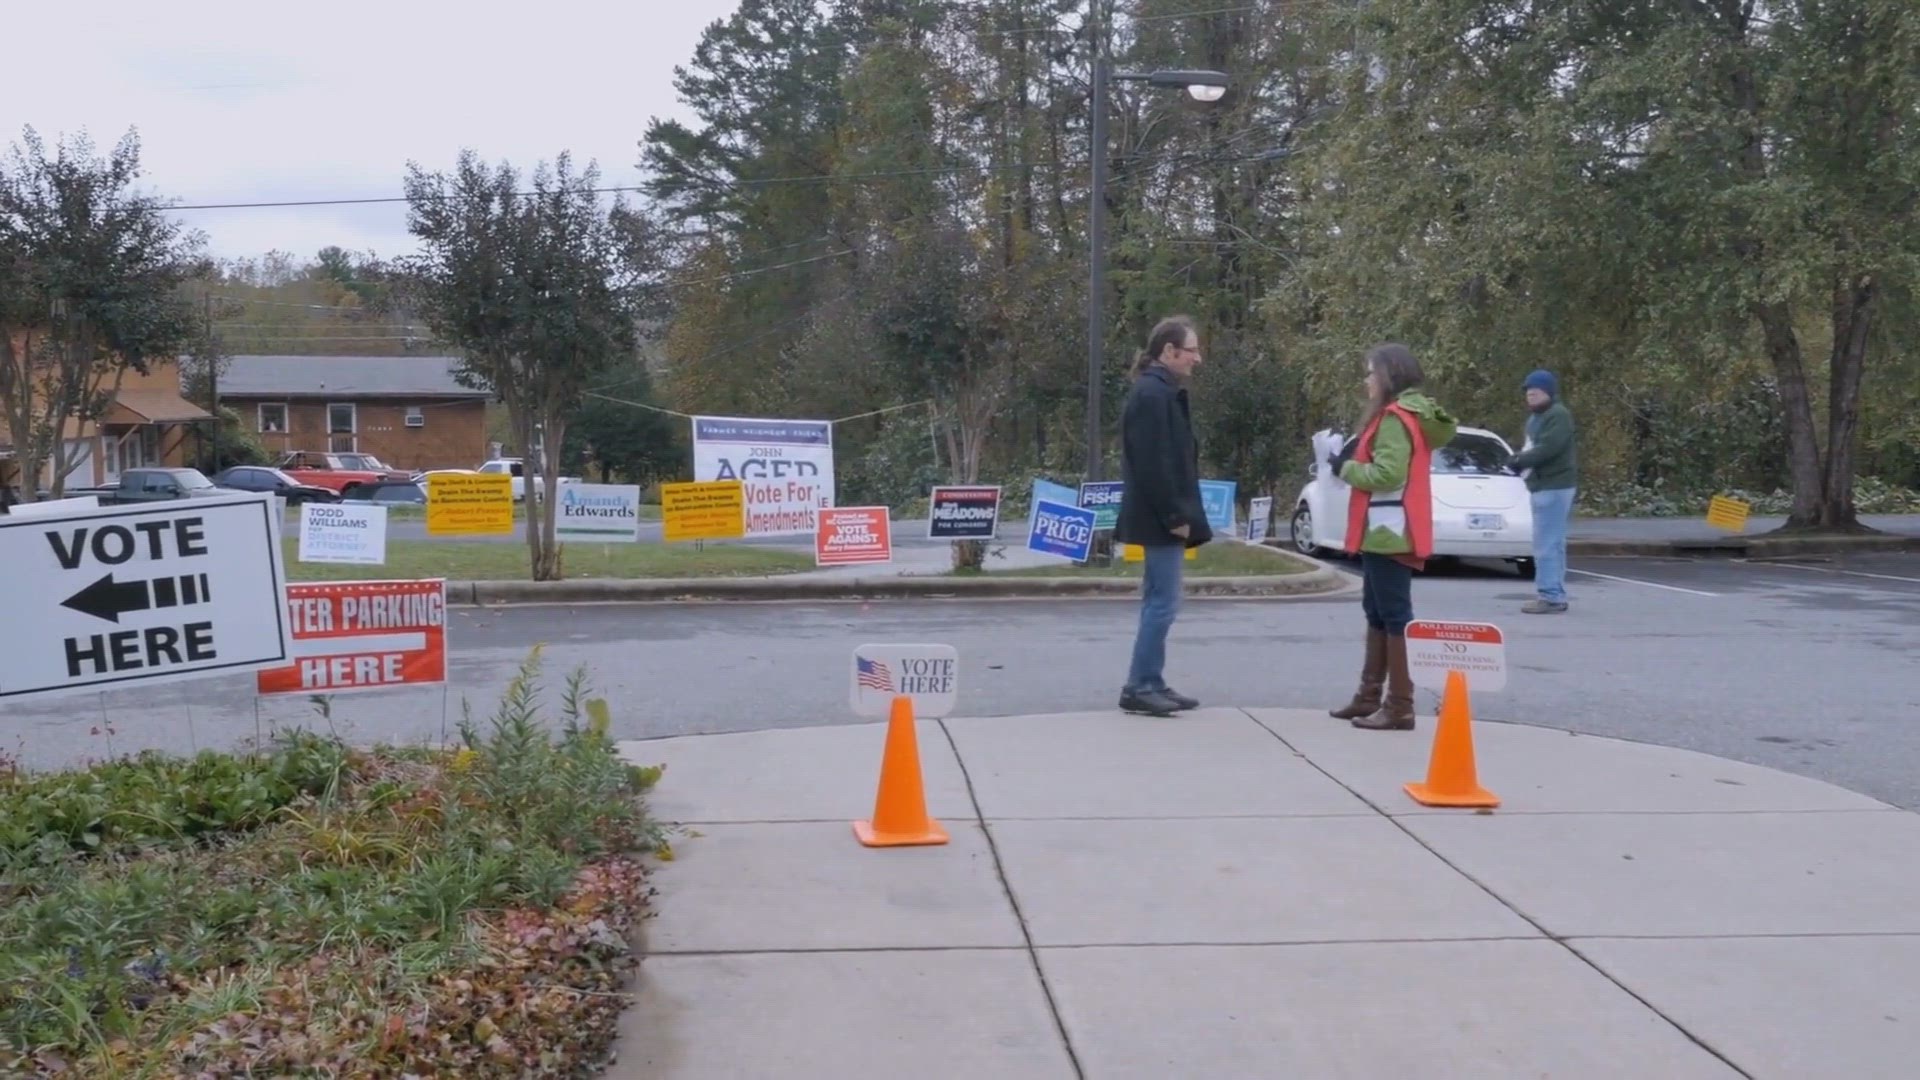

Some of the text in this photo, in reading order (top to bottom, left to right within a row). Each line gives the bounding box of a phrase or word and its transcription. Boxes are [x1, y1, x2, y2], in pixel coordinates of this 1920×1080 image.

[749, 447, 783, 458] JOHN
[561, 489, 630, 506] Amanda
[744, 482, 812, 504] Vote For
[1083, 491, 1123, 504] FISHE
[309, 508, 344, 518] TODD
[565, 505, 635, 518] Edwards
[934, 507, 994, 520] MEADOWS
[309, 517, 368, 529] WILLIAMS
[746, 506, 815, 533] Amendments
[308, 532, 360, 541] DISTRICT
[836, 525, 869, 534] VOTE
[1034, 516, 1090, 544] PRICE
[45, 517, 208, 570] VOTE
[828, 533, 879, 544] AGAINST
[289, 592, 442, 633] TER PARKING
[64, 621, 217, 677] HERE
[1443, 642, 1468, 653] NO
[301, 654, 404, 688] HERE
[901, 658, 954, 676] VOTE
[900, 677, 953, 694] HERE
